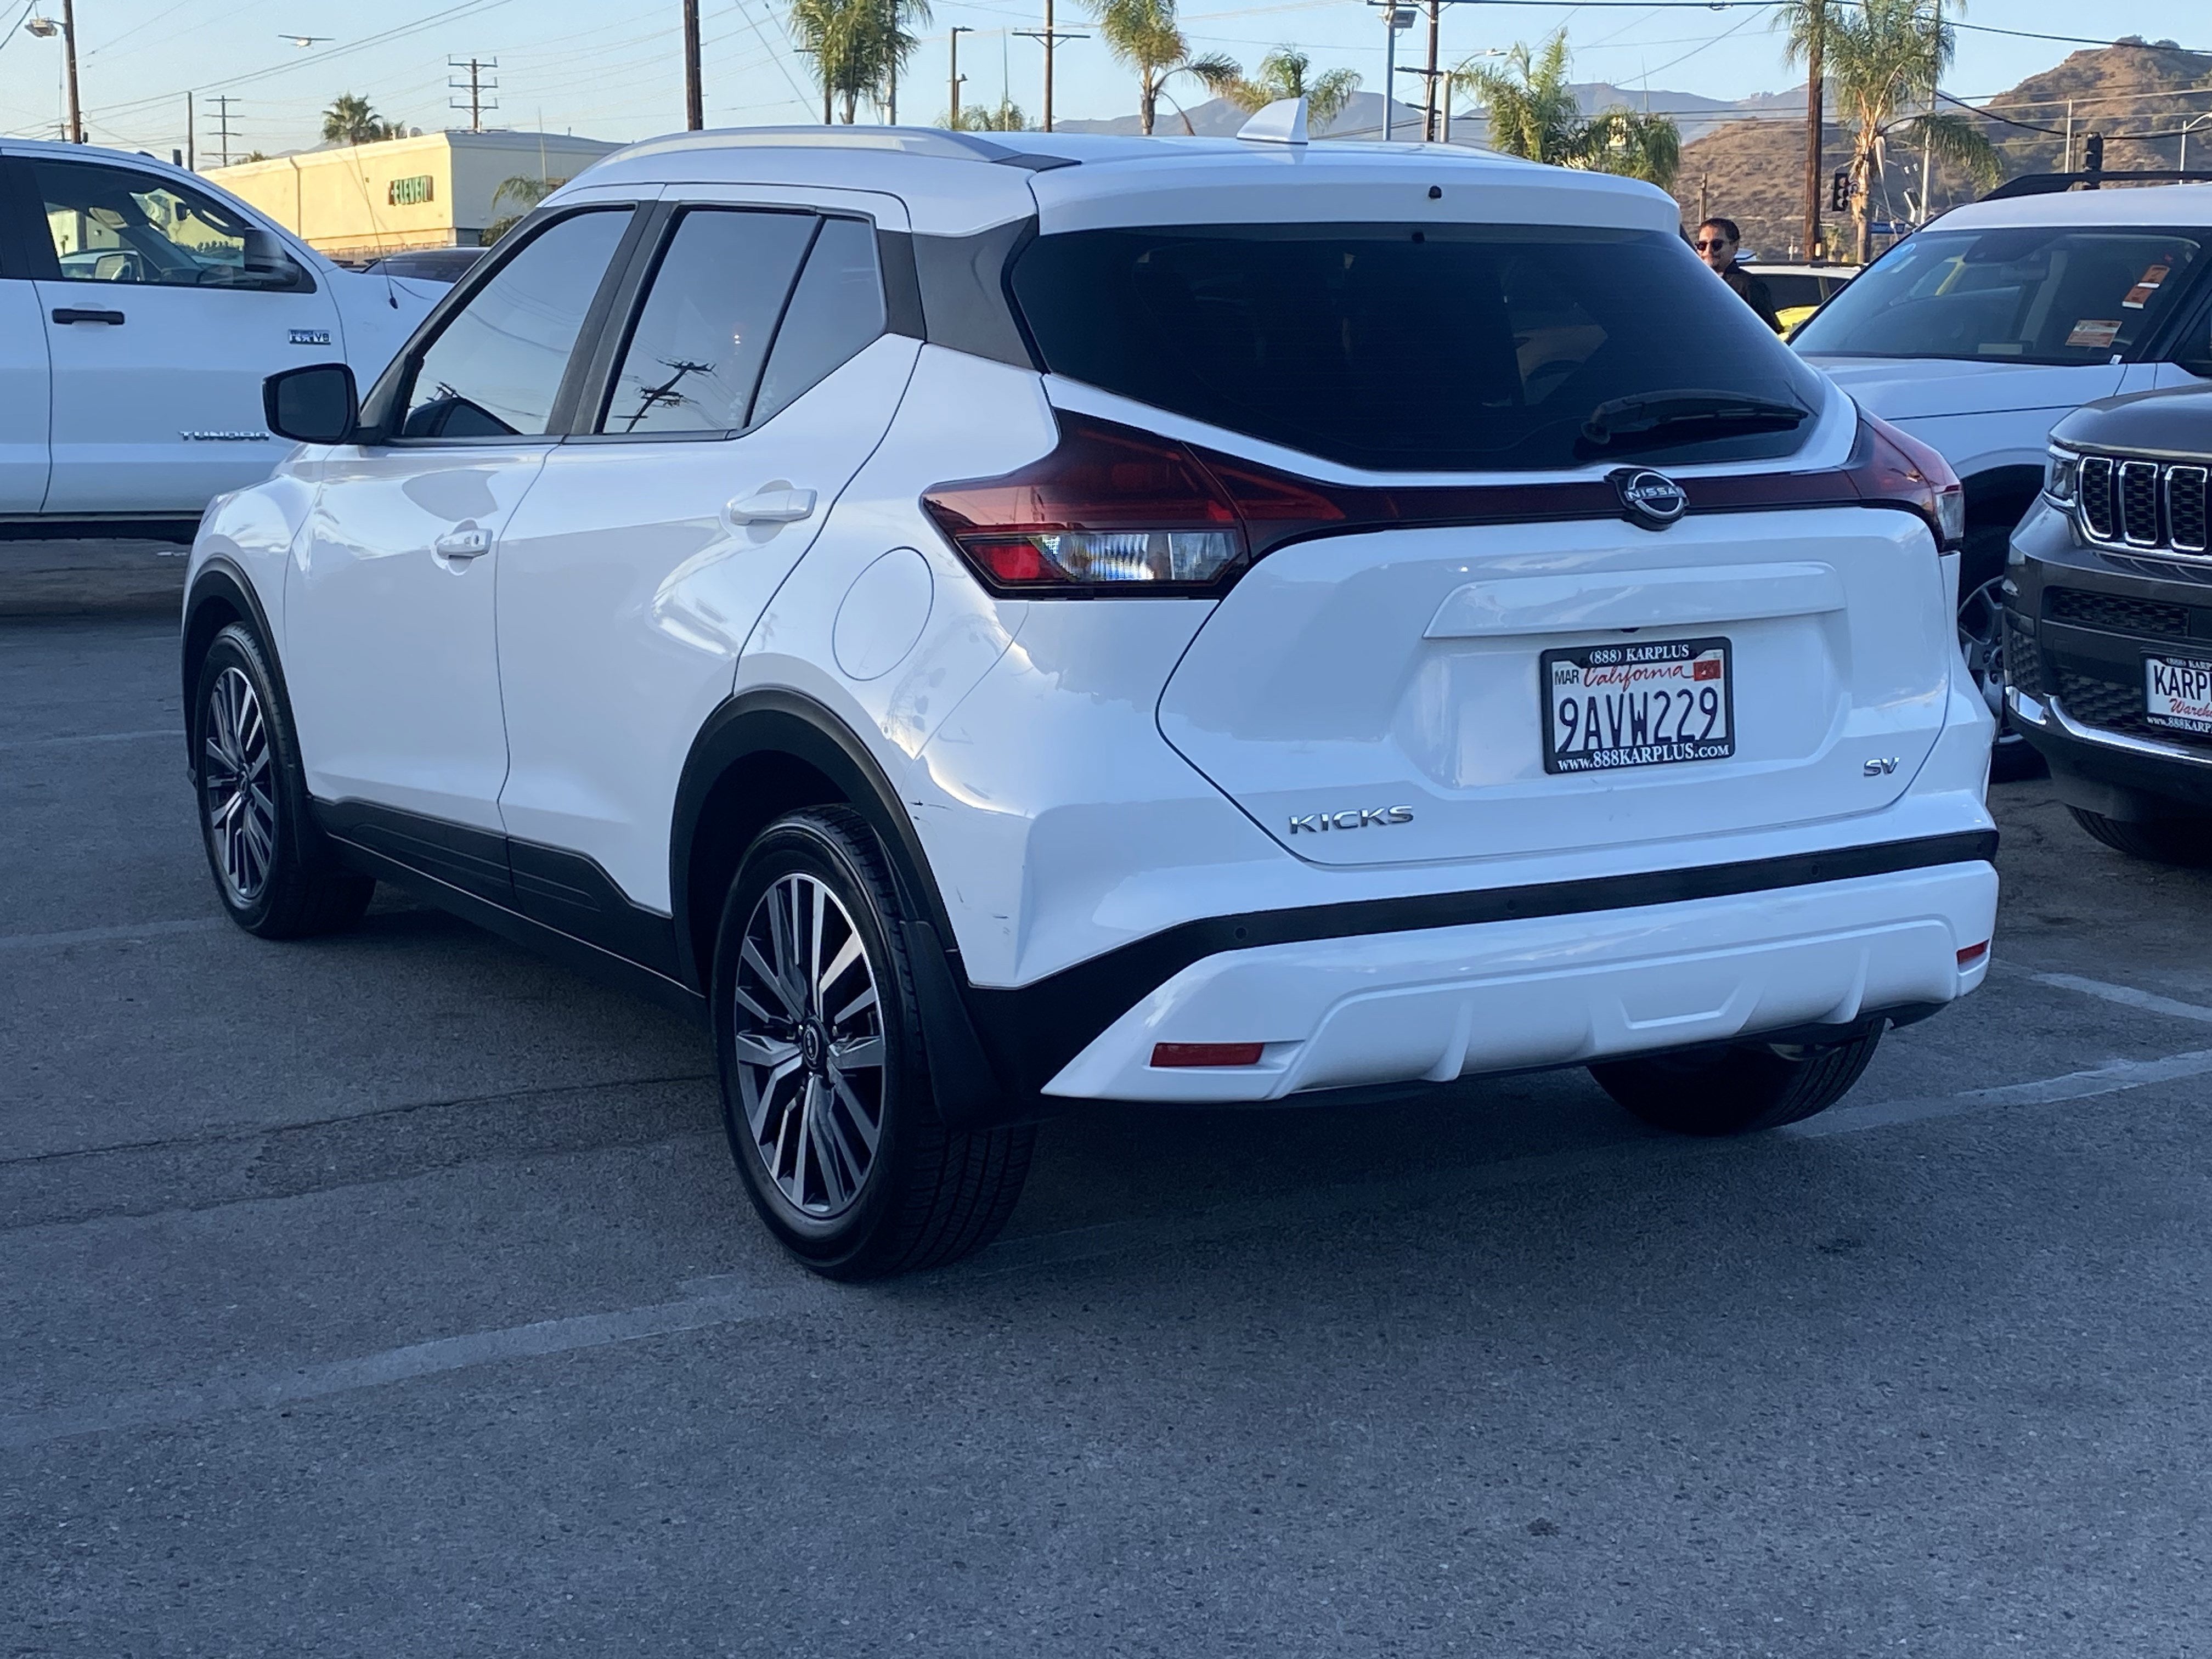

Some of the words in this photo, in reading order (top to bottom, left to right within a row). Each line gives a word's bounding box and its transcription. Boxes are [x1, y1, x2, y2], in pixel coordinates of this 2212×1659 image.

[1589, 648, 1622, 664] (888)
[1626, 644, 1690, 662] KARPLUS
[1554, 669, 1579, 685] MAR
[1583, 664, 1694, 692] California
[2154, 665, 2212, 702] KARP
[1557, 686, 1719, 752] 9AVW229
[2169, 698, 2212, 718] Wareh
[1864, 757, 1900, 777] SV
[1289, 804, 1414, 834] KICKS
